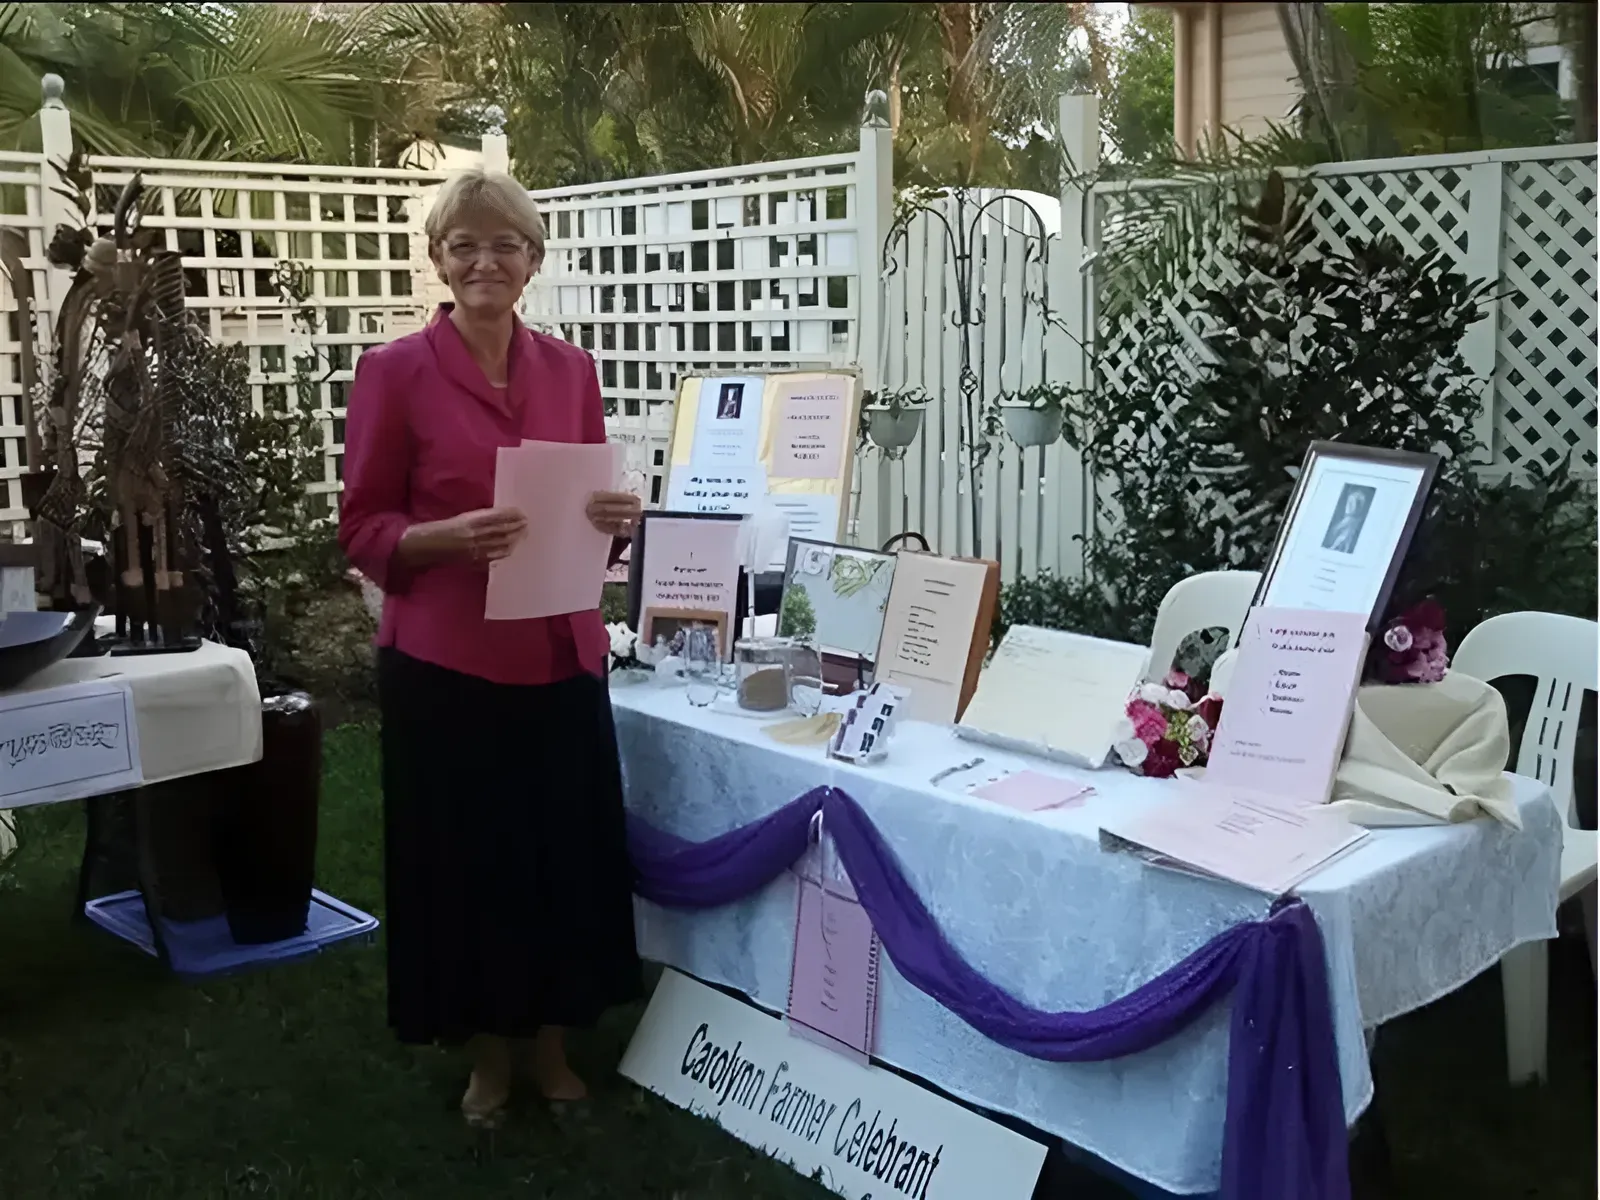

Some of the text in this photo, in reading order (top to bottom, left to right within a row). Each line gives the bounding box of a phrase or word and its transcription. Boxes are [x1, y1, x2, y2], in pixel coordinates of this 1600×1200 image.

[680, 1022, 944, 1200] Carolynn Farmer Celebrant
